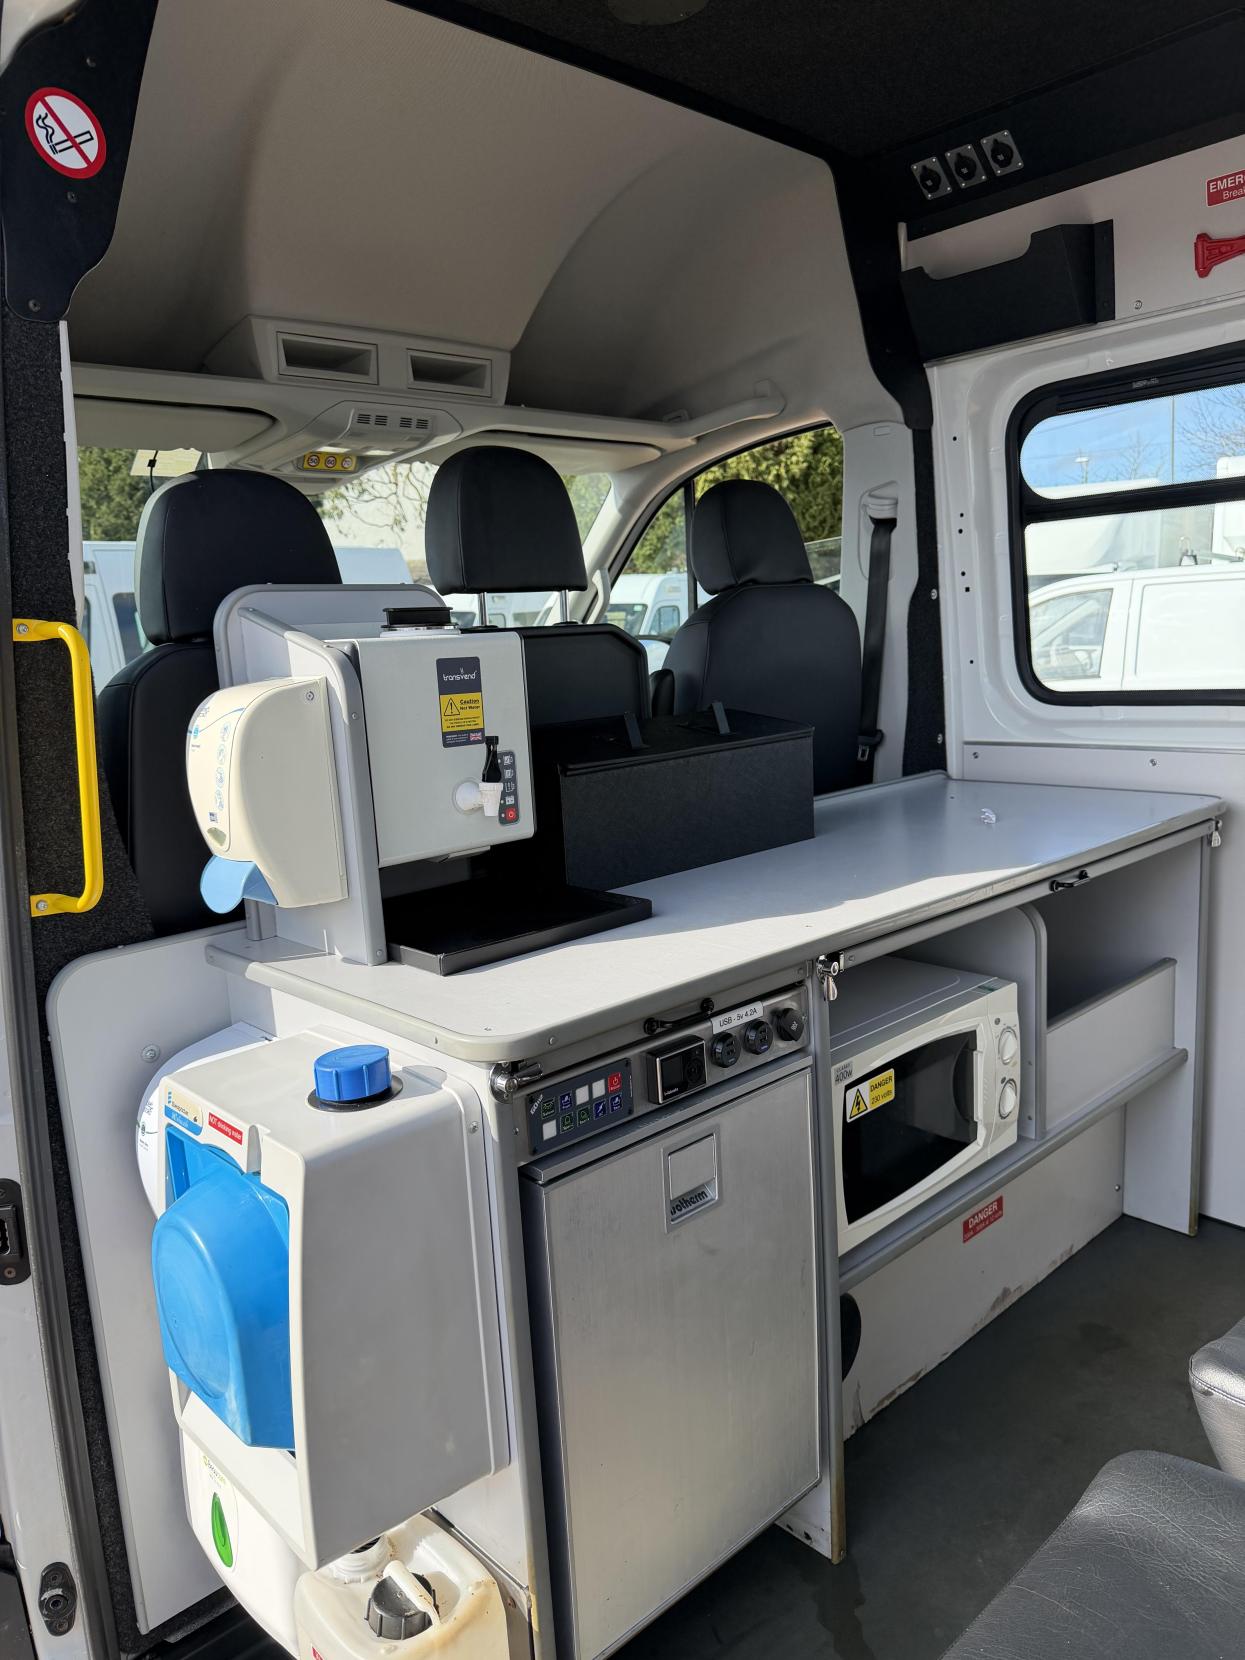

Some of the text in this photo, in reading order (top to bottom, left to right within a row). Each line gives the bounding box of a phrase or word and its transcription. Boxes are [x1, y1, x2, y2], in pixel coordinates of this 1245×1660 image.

[1210, 174, 1245, 193] EMER
[1223, 187, 1245, 200] Brea
[443, 668, 477, 681] transvend
[719, 1016, 732, 1027] USB
[736, 1011, 744, 1021] 5v
[744, 1007, 758, 1018] 4.2A
[870, 1075, 893, 1093] DANGER
[871, 1094, 881, 1105] 230
[209, 1113, 242, 1140] NOT drinking water
[968, 1200, 998, 1229] DANGER
